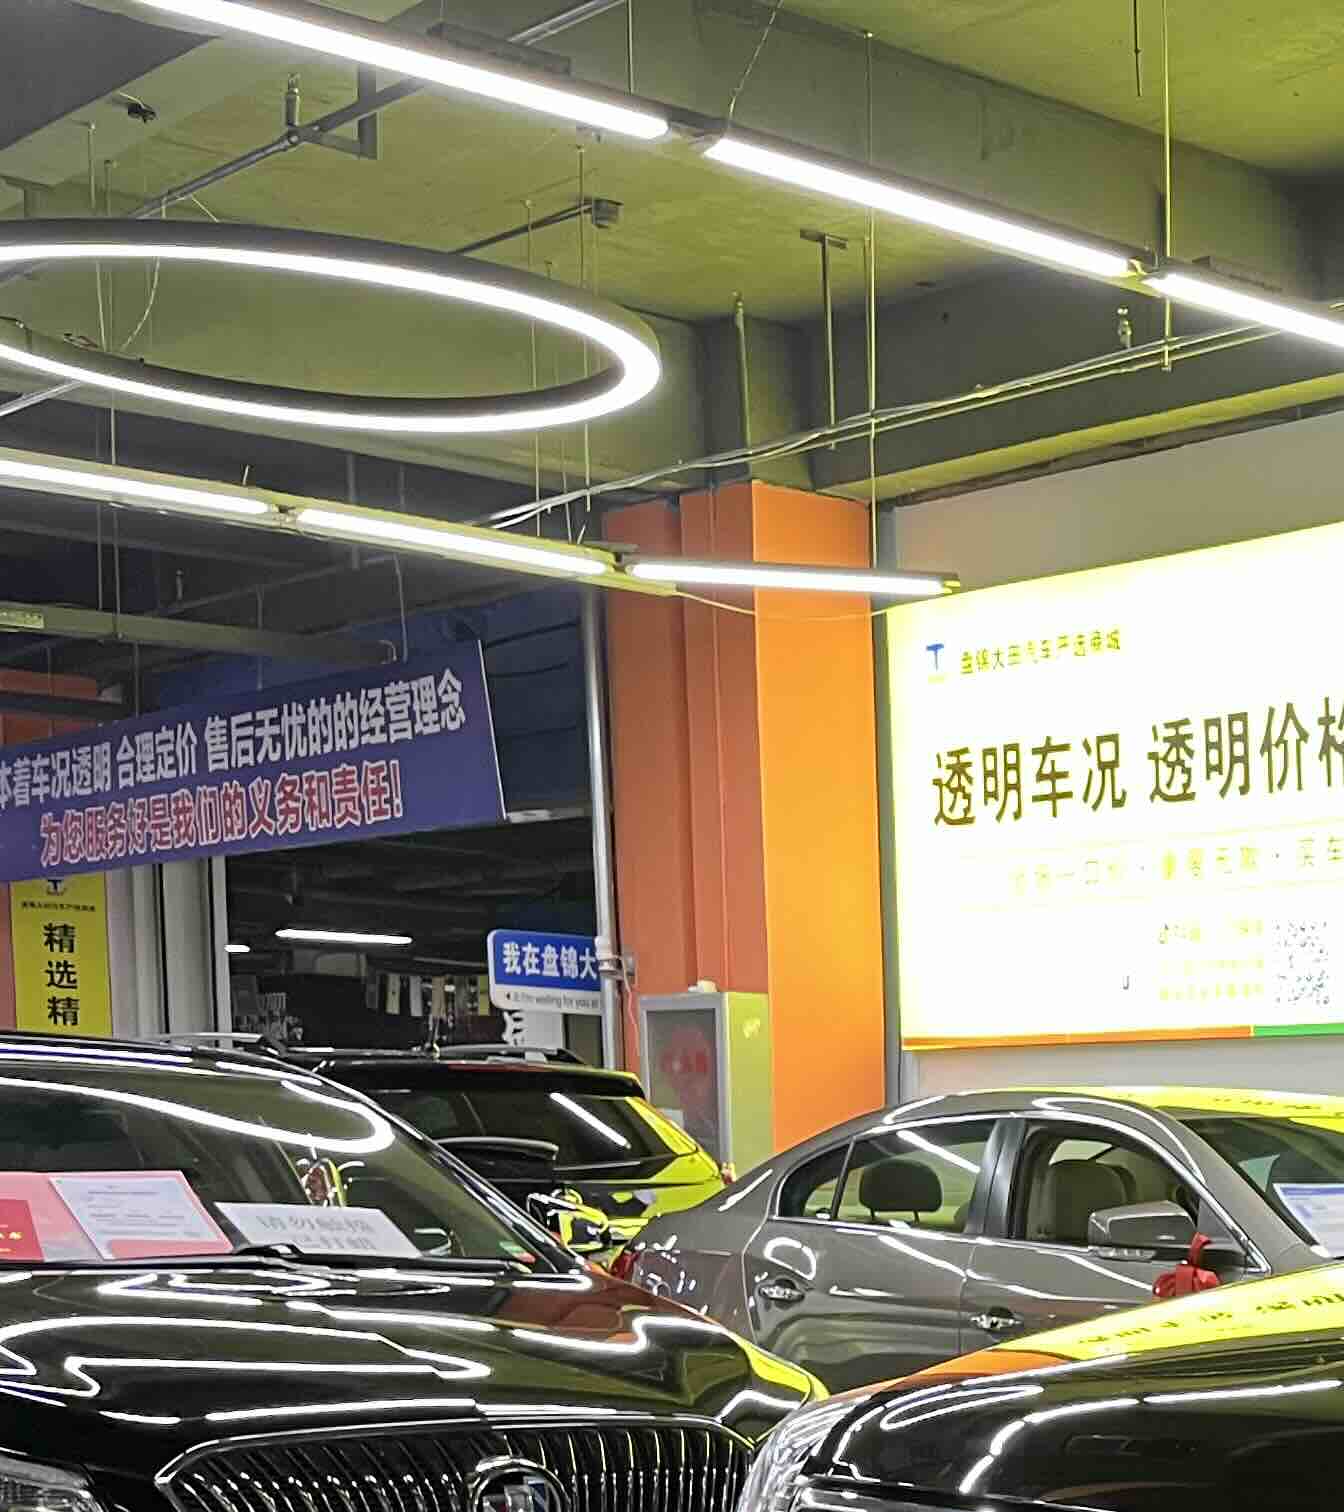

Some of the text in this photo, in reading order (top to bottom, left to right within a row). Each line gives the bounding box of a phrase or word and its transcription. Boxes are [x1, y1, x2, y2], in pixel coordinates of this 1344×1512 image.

[116, 721, 198, 789] 合理定价
[204, 668, 466, 774] 售后无忧的的经营理念
[931, 733, 1128, 827] 透明车况
[43, 922, 81, 1026] 精选精
[502, 941, 597, 980] 我在盘锦大
